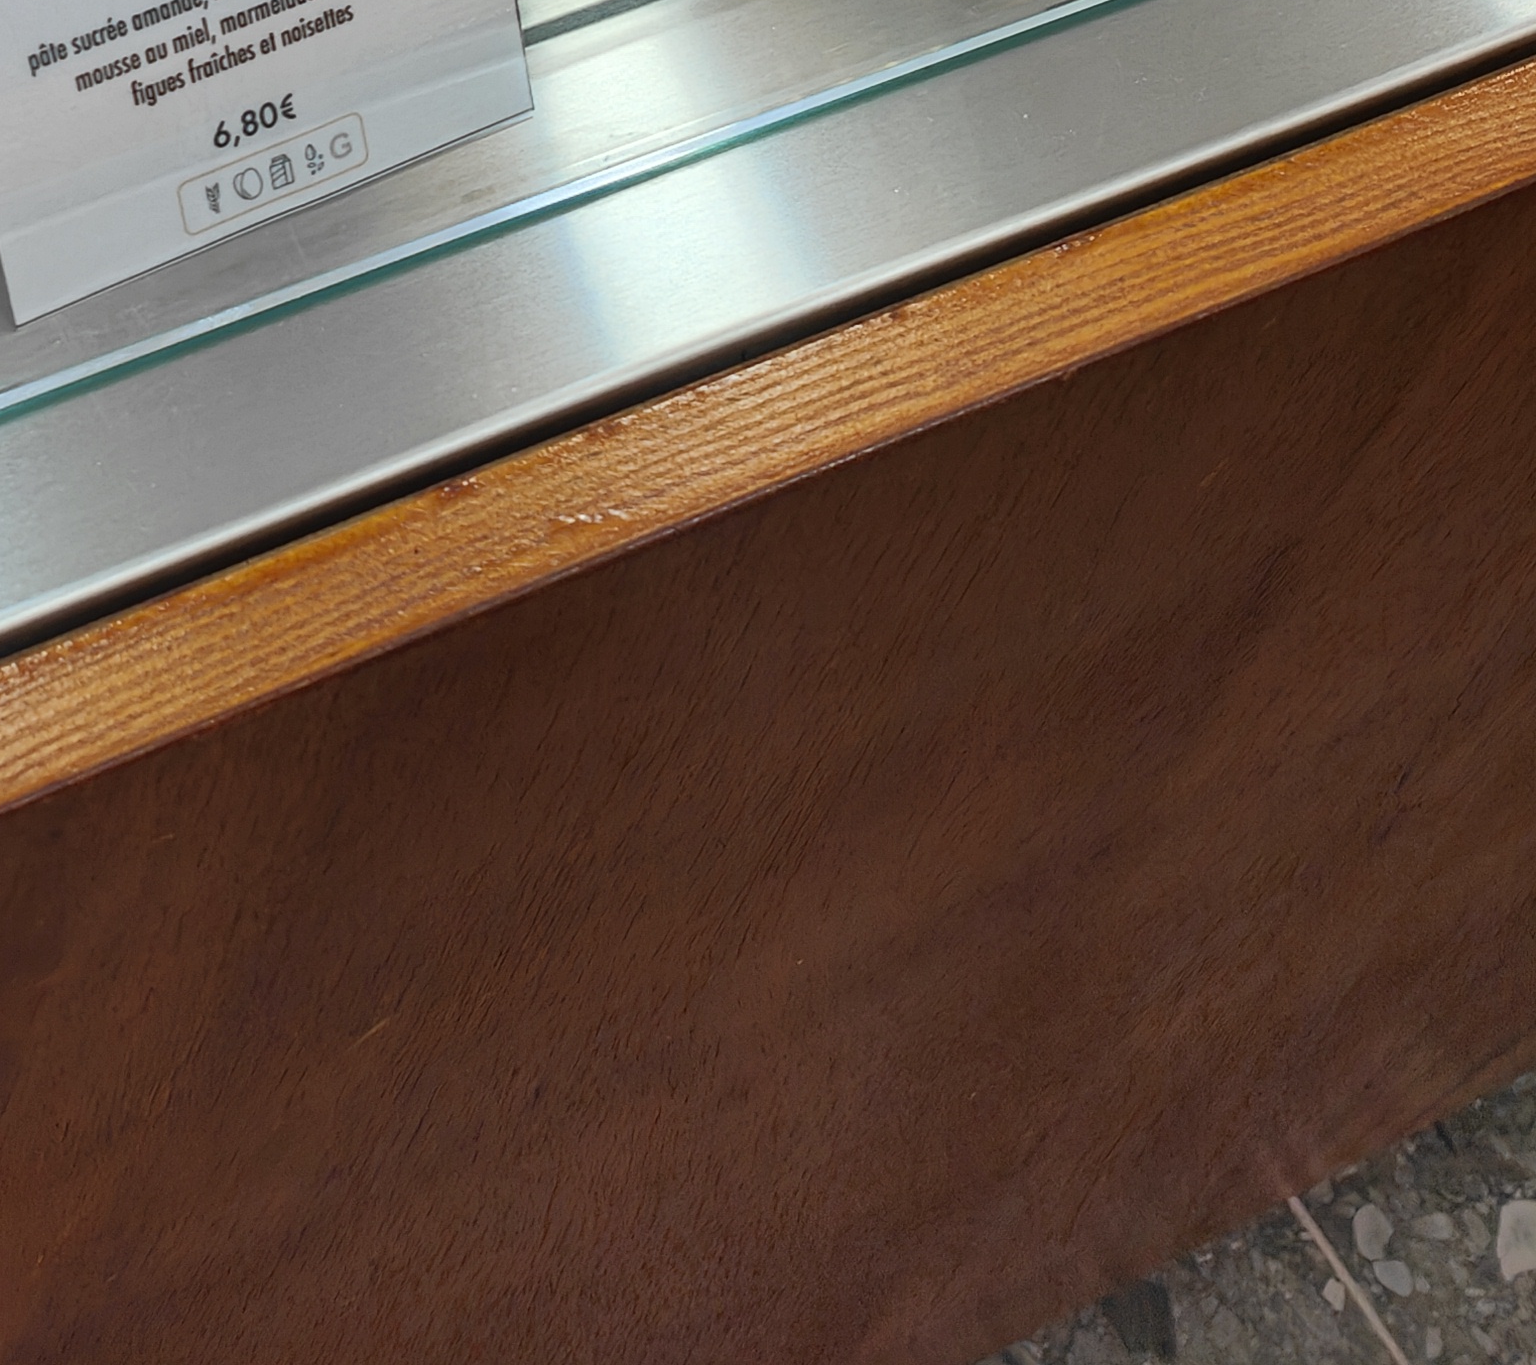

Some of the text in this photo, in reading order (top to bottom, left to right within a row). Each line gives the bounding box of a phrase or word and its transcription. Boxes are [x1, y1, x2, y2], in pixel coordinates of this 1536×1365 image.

[27, 43, 68, 77] pâte
[70, 17, 128, 55] sucrée
[75, 53, 142, 92] mousse
[144, 42, 168, 64] au
[172, 17, 216, 54] miel,
[131, 5, 354, 106] figues fraîches et noisettes
[212, 92, 298, 149] 6,80€
